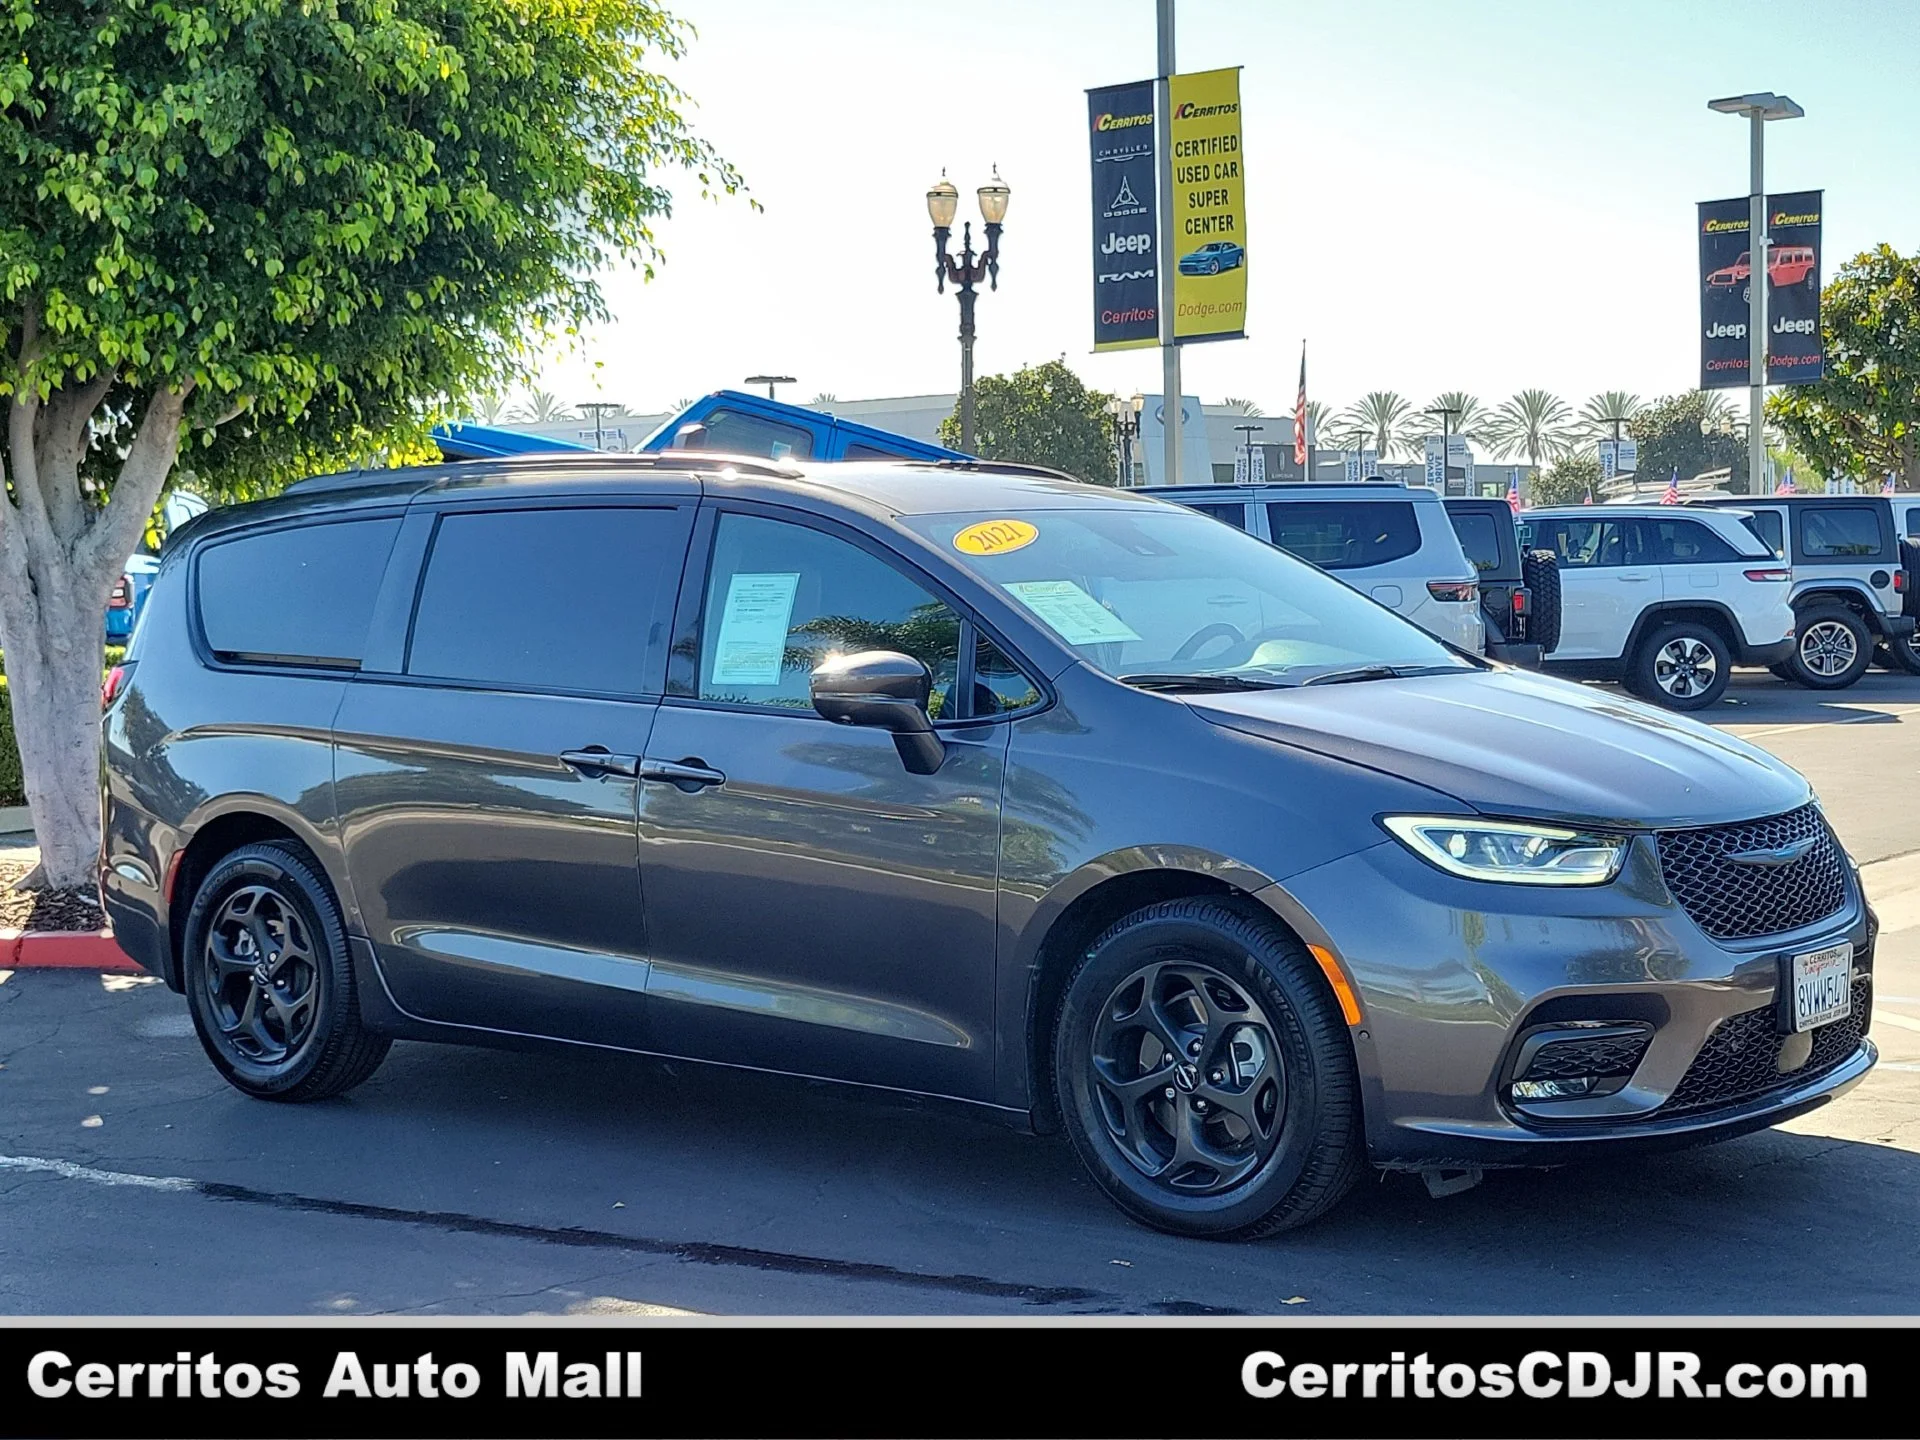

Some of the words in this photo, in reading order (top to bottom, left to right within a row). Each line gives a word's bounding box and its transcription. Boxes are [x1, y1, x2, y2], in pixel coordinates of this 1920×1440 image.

[1180, 102, 1238, 119] CERRITOS
[1098, 113, 1153, 131] CERRITOS
[1099, 144, 1148, 157] CHRYSLER
[1175, 134, 1238, 158] CERTIFIED
[1177, 164, 1210, 184] USED
[1214, 161, 1238, 180] CAR
[1188, 189, 1229, 209] SUPER
[1103, 207, 1148, 218] DODGE
[1185, 214, 1234, 235] CENTER
[1101, 232, 1151, 255] Jeep
[1099, 269, 1154, 283] RAM
[1101, 307, 1155, 325] Cerritos
[1178, 301, 1242, 318] Dodge.com
[1706, 322, 1746, 340] Jeep
[1772, 316, 1815, 335] Jeep
[1705, 358, 1750, 371] Cerritos
[1769, 354, 1820, 368] Dodge.com
[1427, 451, 1435, 487] SERVICE
[1435, 455, 1443, 483] DRIVE
[968, 521, 1026, 551] 2021
[1799, 973, 1847, 1017] 8YWW547
